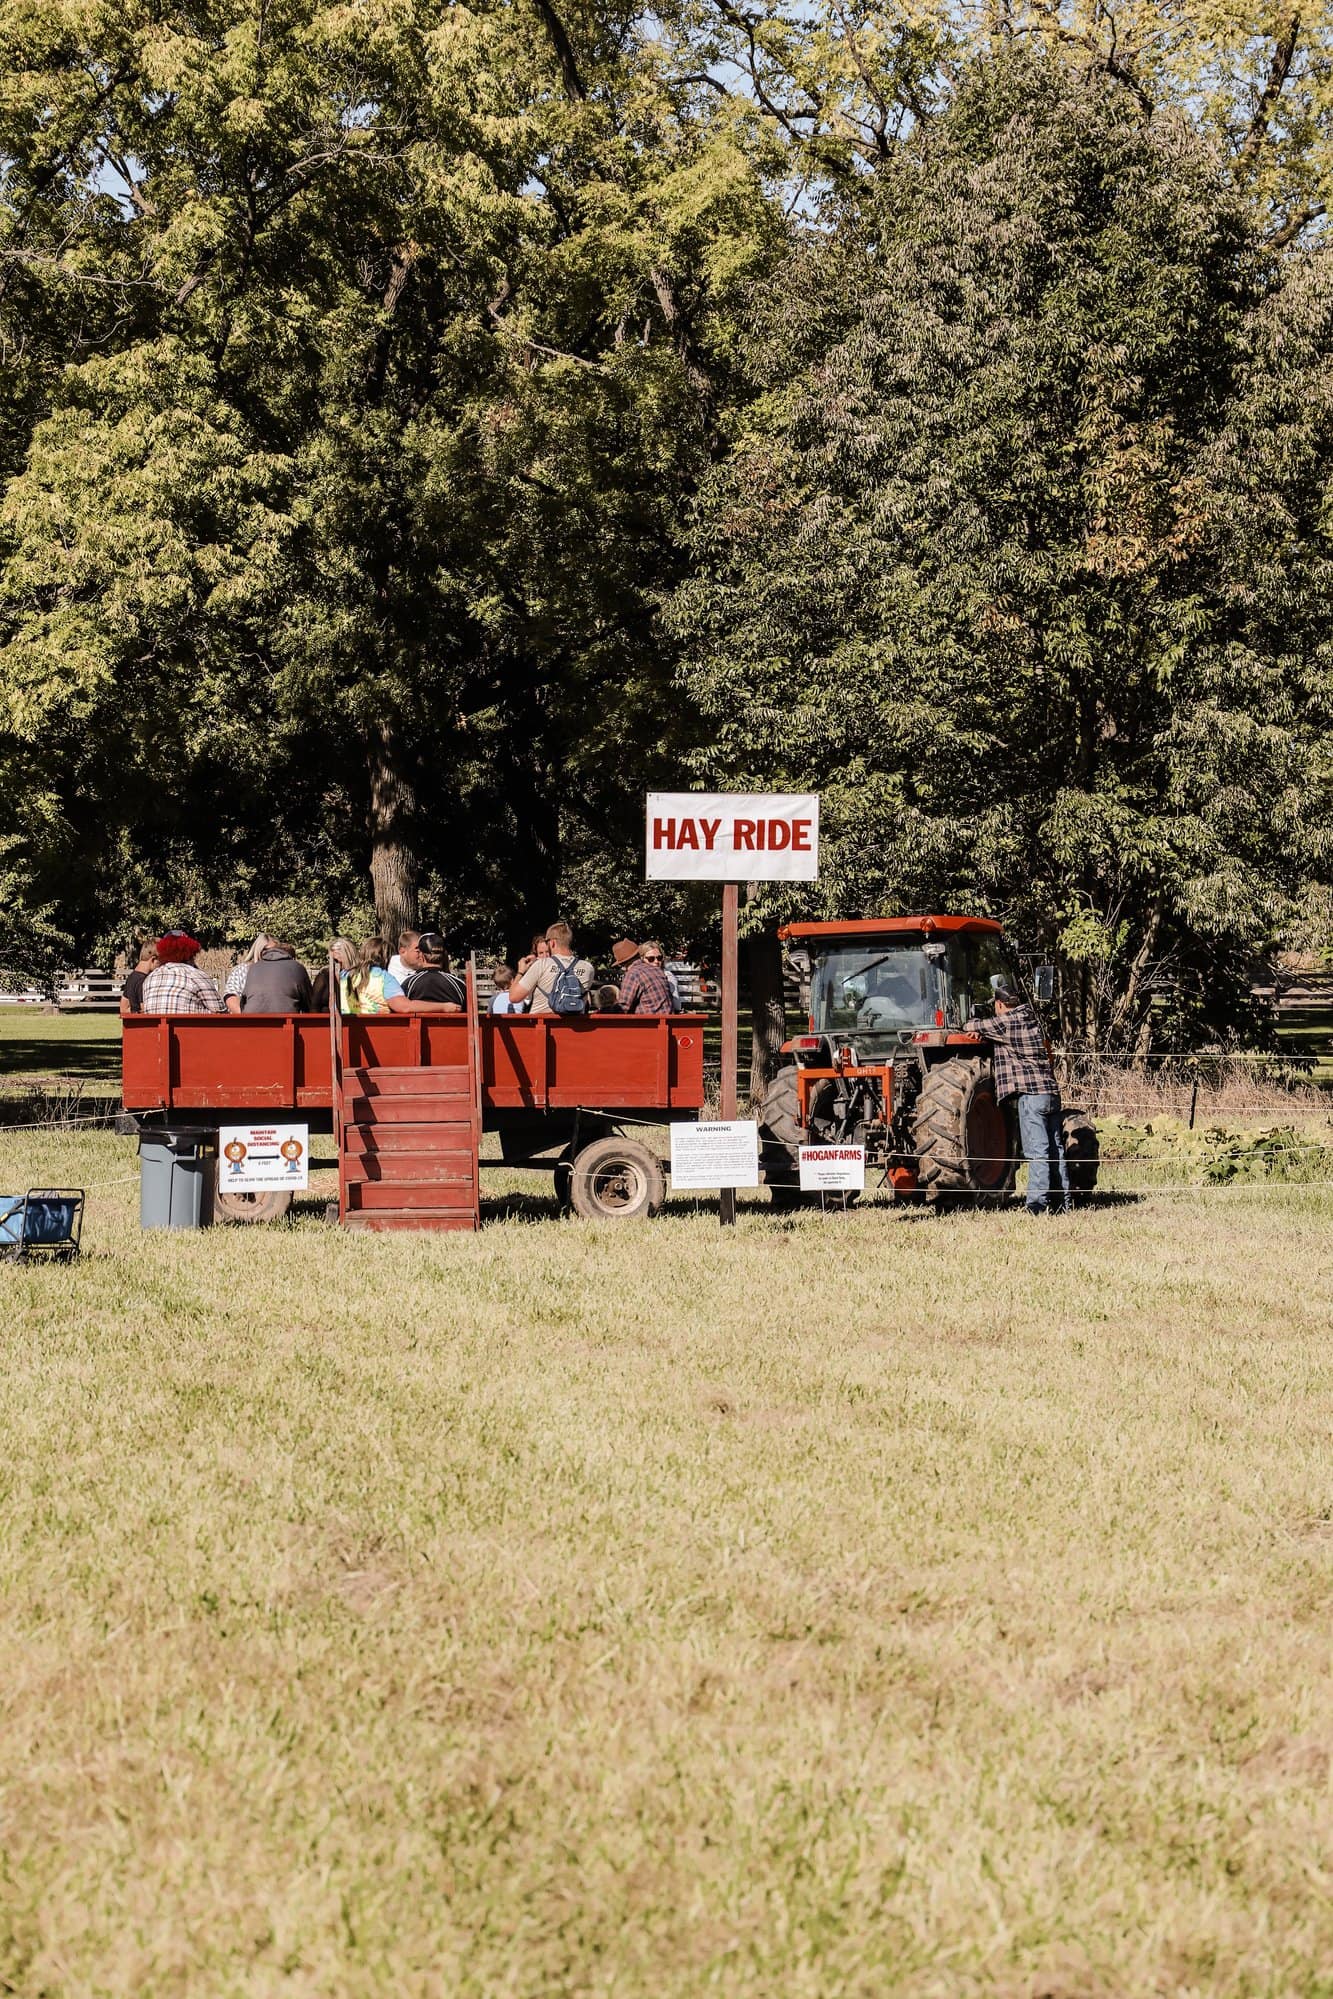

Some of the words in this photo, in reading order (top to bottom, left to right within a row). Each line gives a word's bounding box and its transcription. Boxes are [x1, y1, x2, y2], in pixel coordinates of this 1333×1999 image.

[653, 818, 722, 850] HAY
[733, 819, 812, 851] RIDE
[802, 1150, 862, 1161] #HOGANFARMS
